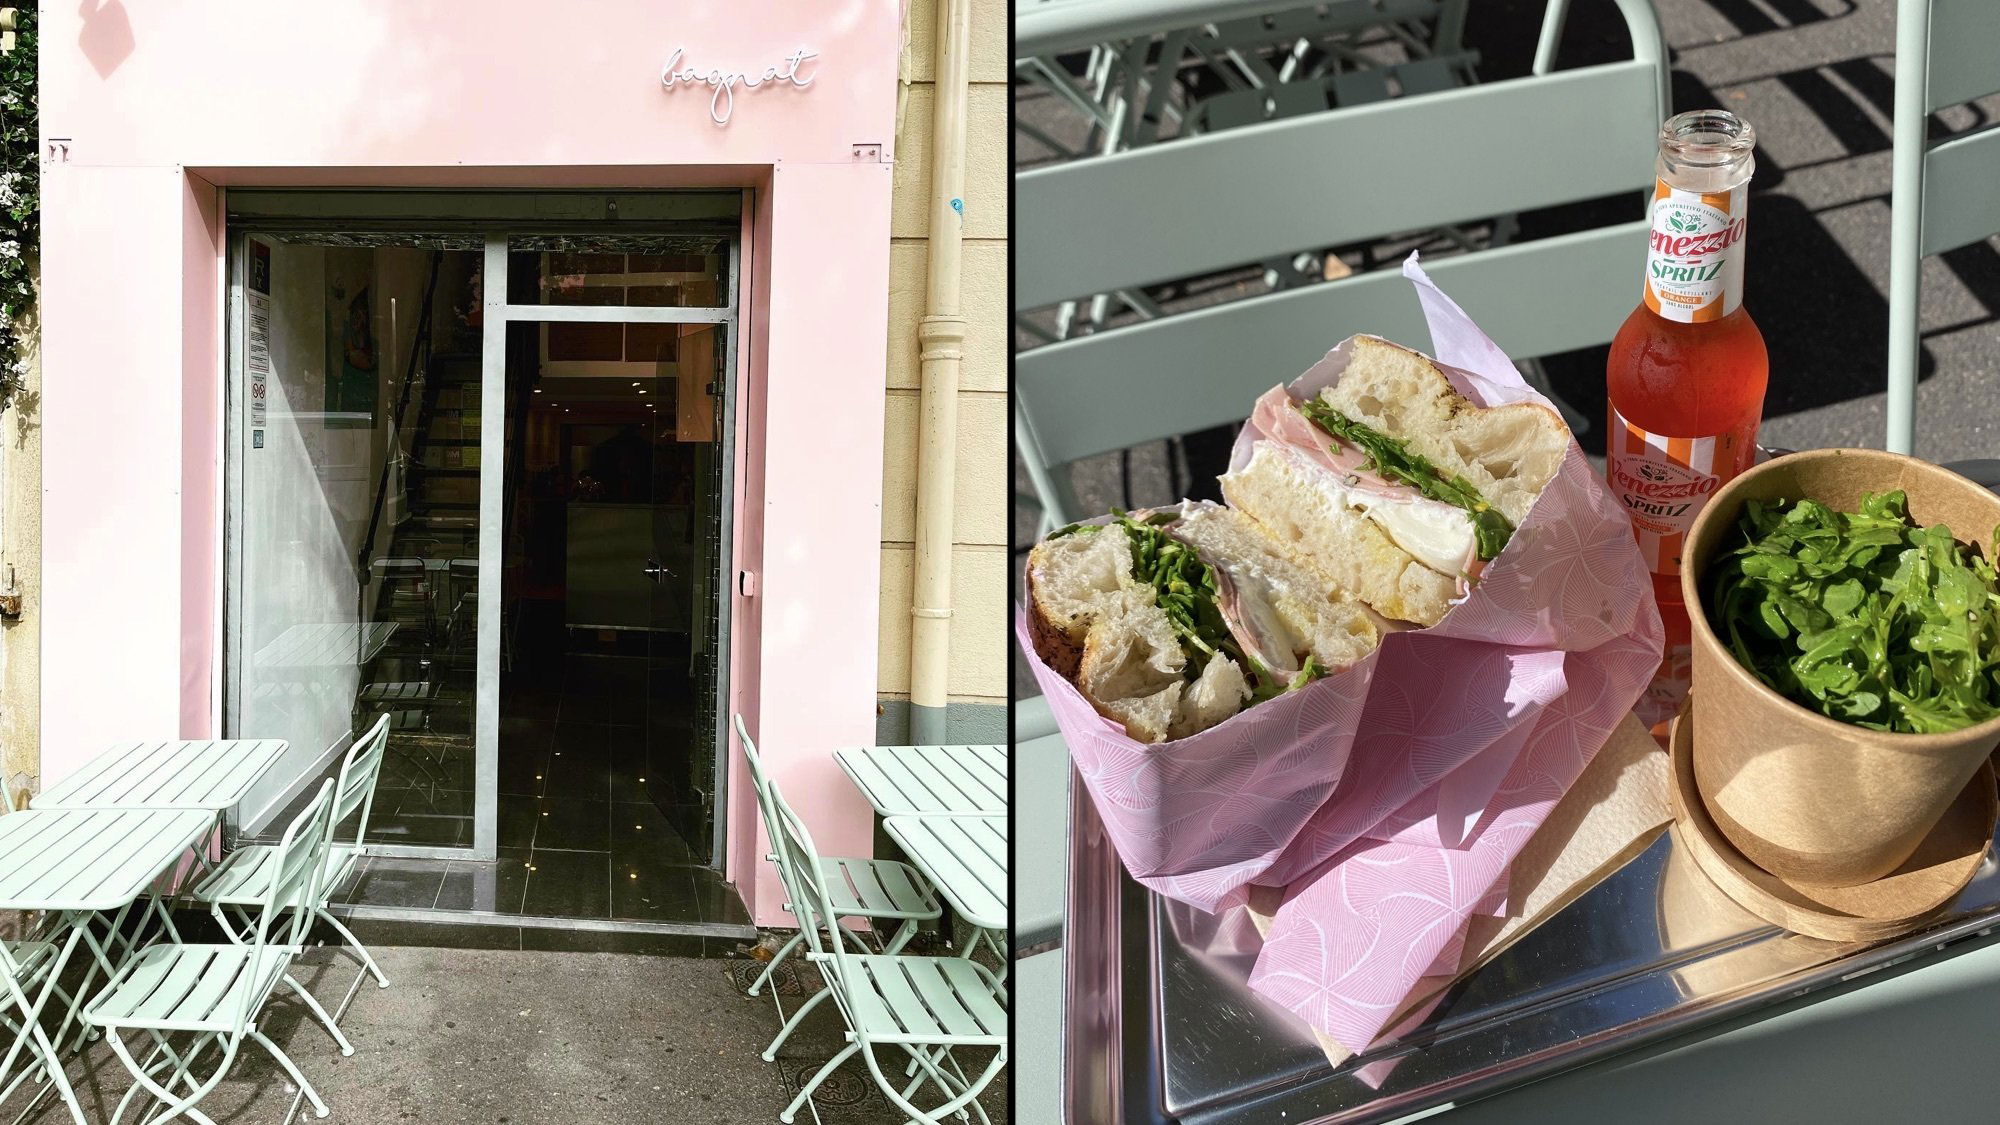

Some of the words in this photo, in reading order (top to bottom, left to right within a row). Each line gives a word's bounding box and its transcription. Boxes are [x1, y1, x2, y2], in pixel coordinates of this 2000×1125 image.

[661, 47, 819, 124] bagnat
[1650, 217, 1745, 257] enezzio
[1651, 259, 1726, 282] SPRITZ
[1664, 292, 1698, 303] ORANGE
[1611, 456, 1718, 499] Venezzio
[1623, 493, 1692, 517] SPRITZ
